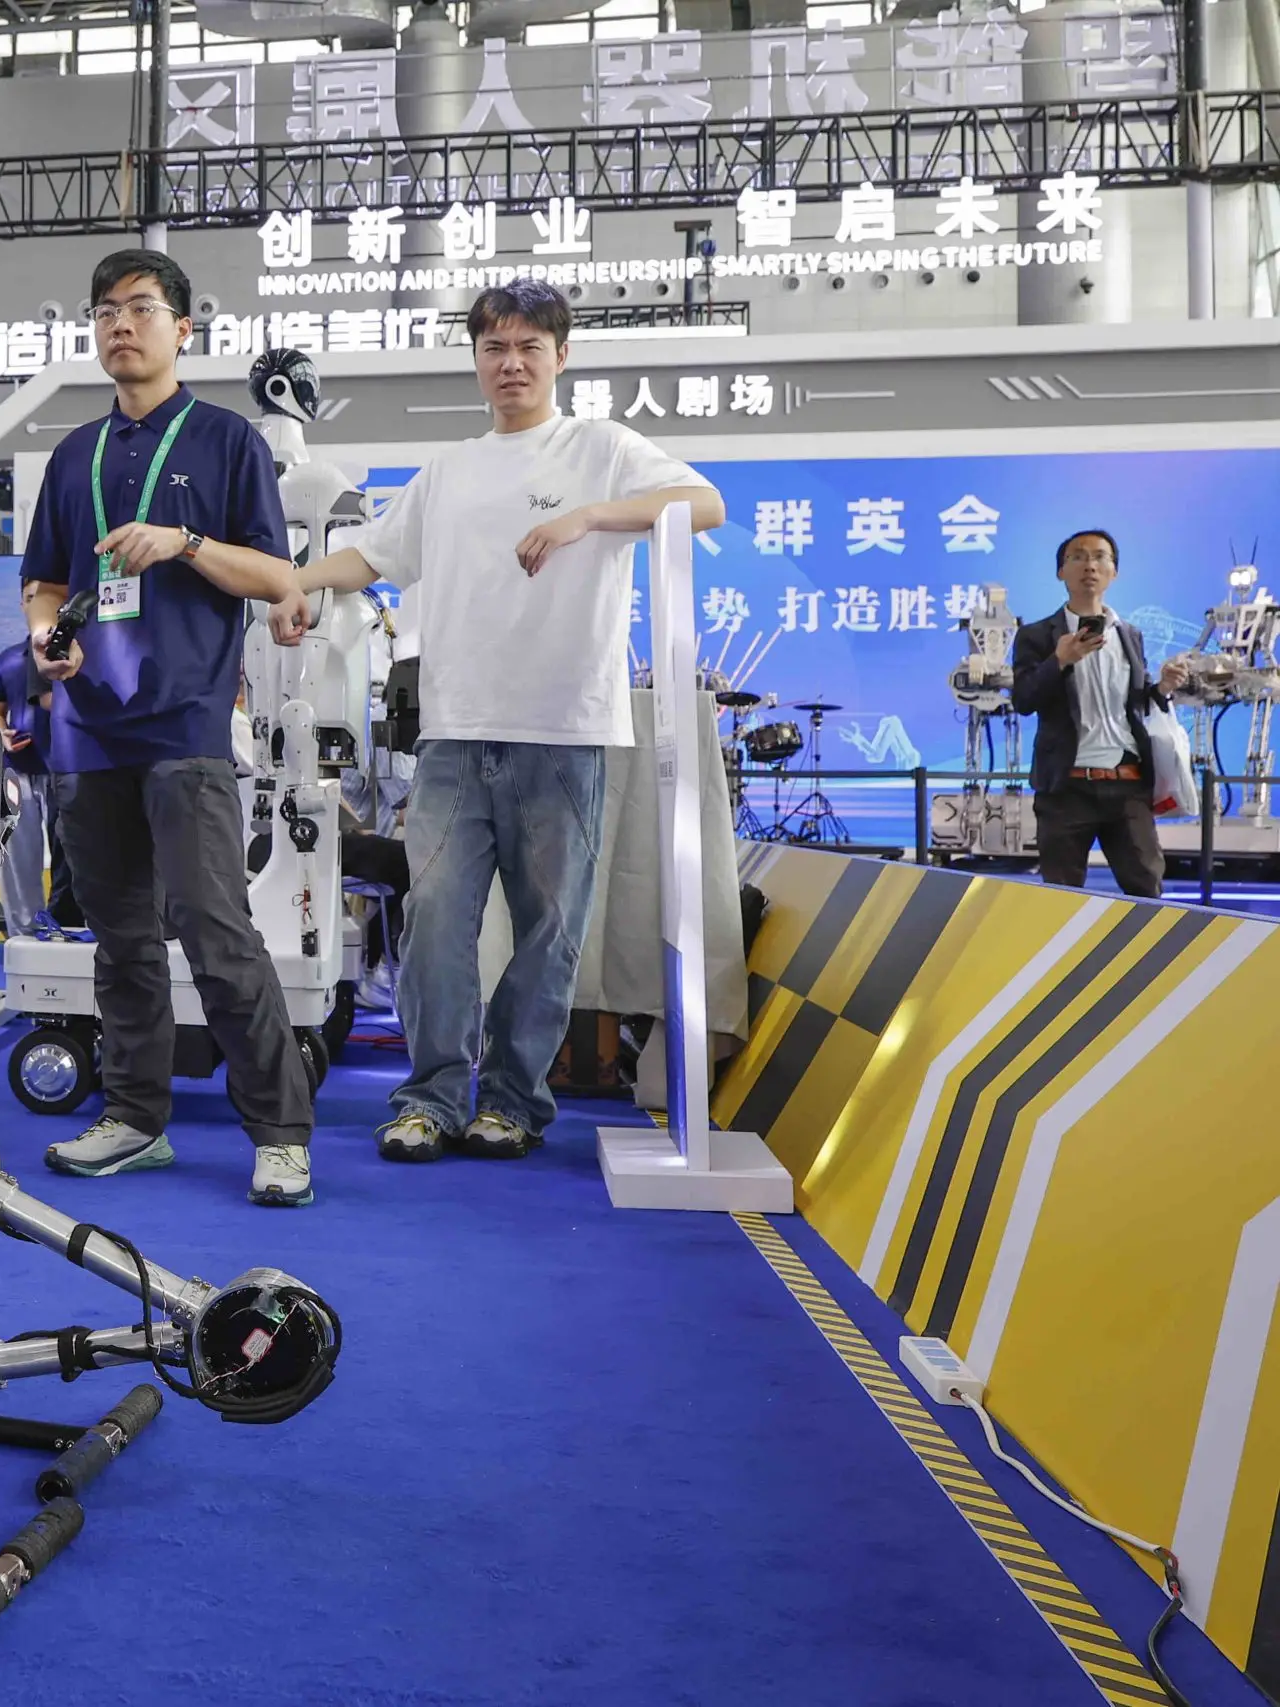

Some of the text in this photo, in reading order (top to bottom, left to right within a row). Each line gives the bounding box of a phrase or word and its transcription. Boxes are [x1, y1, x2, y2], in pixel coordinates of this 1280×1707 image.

[257, 171, 1103, 268] 创新创业 智启未来
[258, 239, 1103, 296] INNOVATION AND ENTREPRENEURSHIP SMARTLY SHAPING THE FUTURE
[210, 308, 474, 357] 创造美好
[552, 374, 773, 419] 器人剧场
